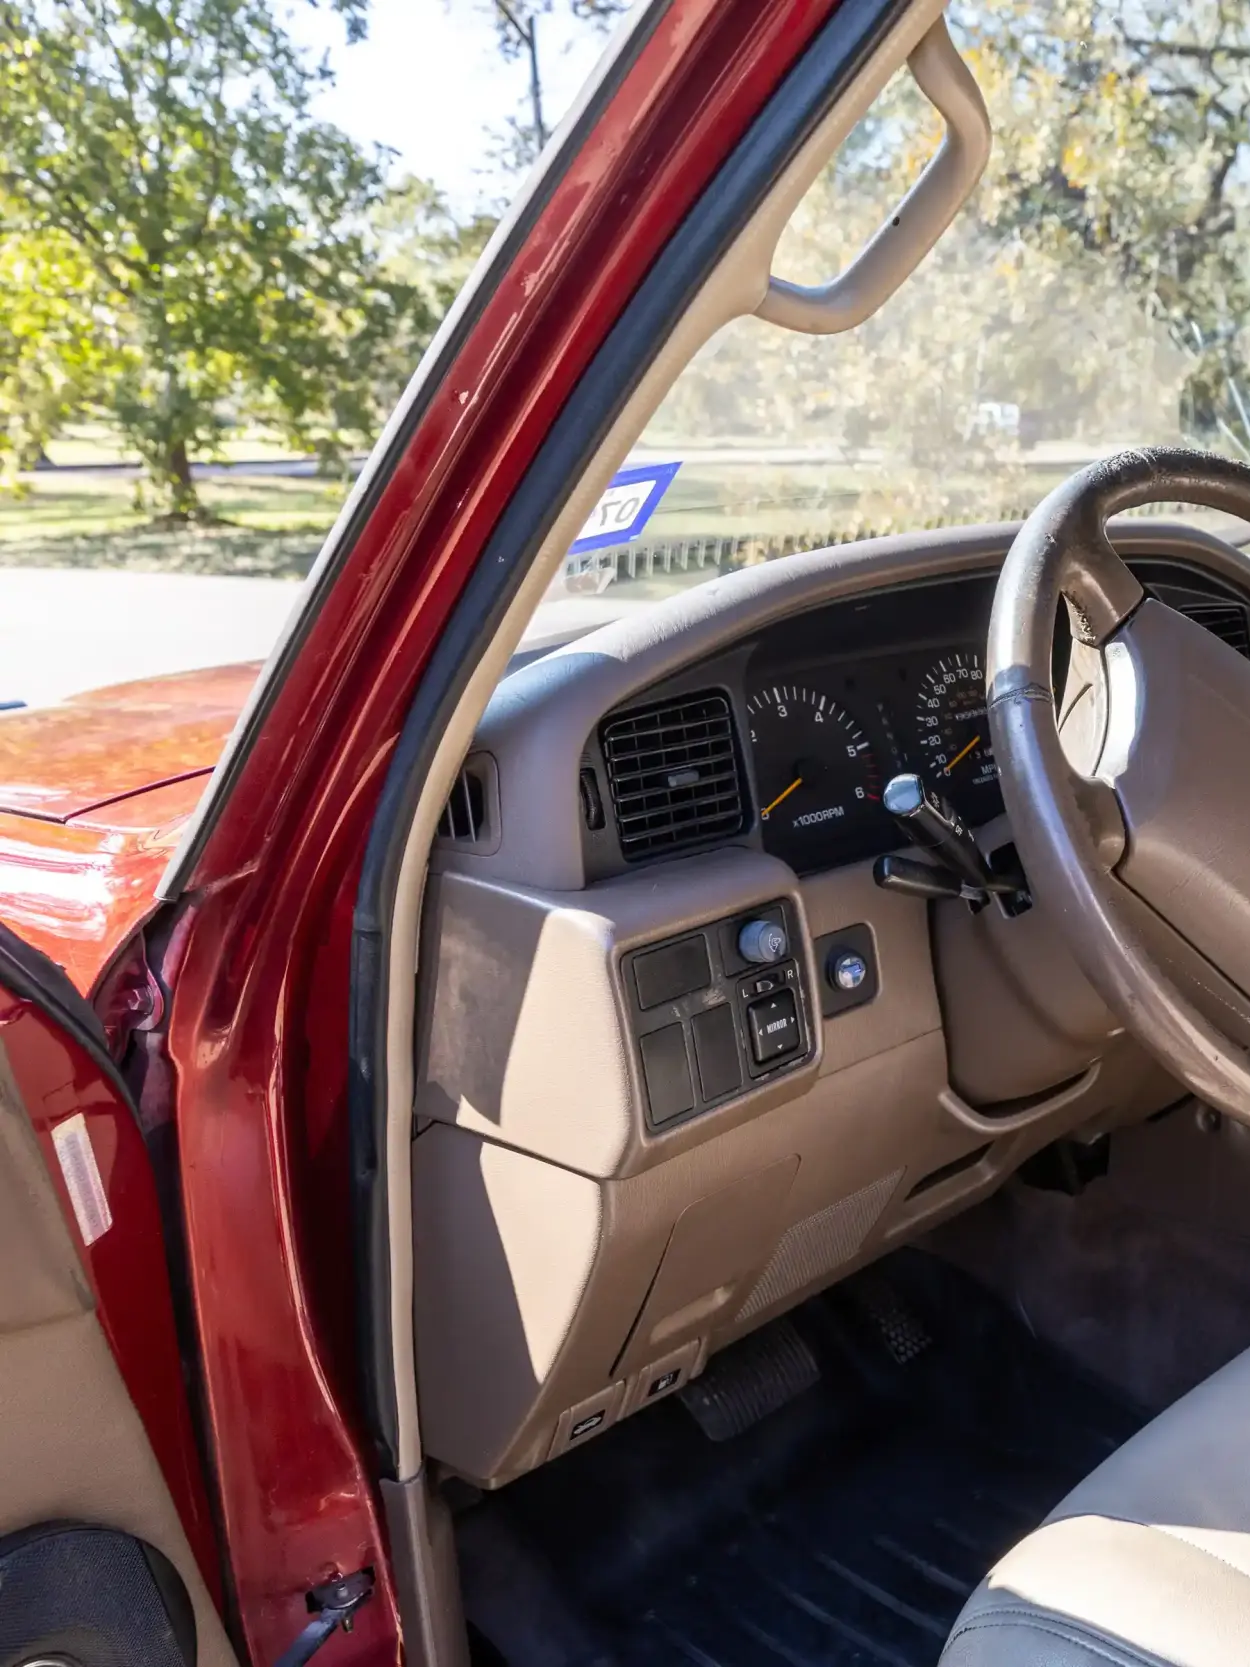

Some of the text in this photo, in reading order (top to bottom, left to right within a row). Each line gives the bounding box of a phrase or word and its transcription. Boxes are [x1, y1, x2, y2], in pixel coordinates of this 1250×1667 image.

[943, 673, 956, 684] 60
[956, 668, 968, 679] 70
[970, 669, 983, 681] 80
[933, 684, 947, 695] 50
[927, 698, 940, 709] 40
[777, 705, 788, 717] 3
[814, 711, 824, 723] 4
[925, 716, 938, 727] 30
[928, 735, 941, 746] 20
[846, 745, 856, 757] 5
[935, 754, 947, 764] 10
[855, 786, 865, 799] 6
[787, 969, 794, 979] R
[742, 988, 749, 998] L
[766, 1018, 788, 1035] MIRROR
